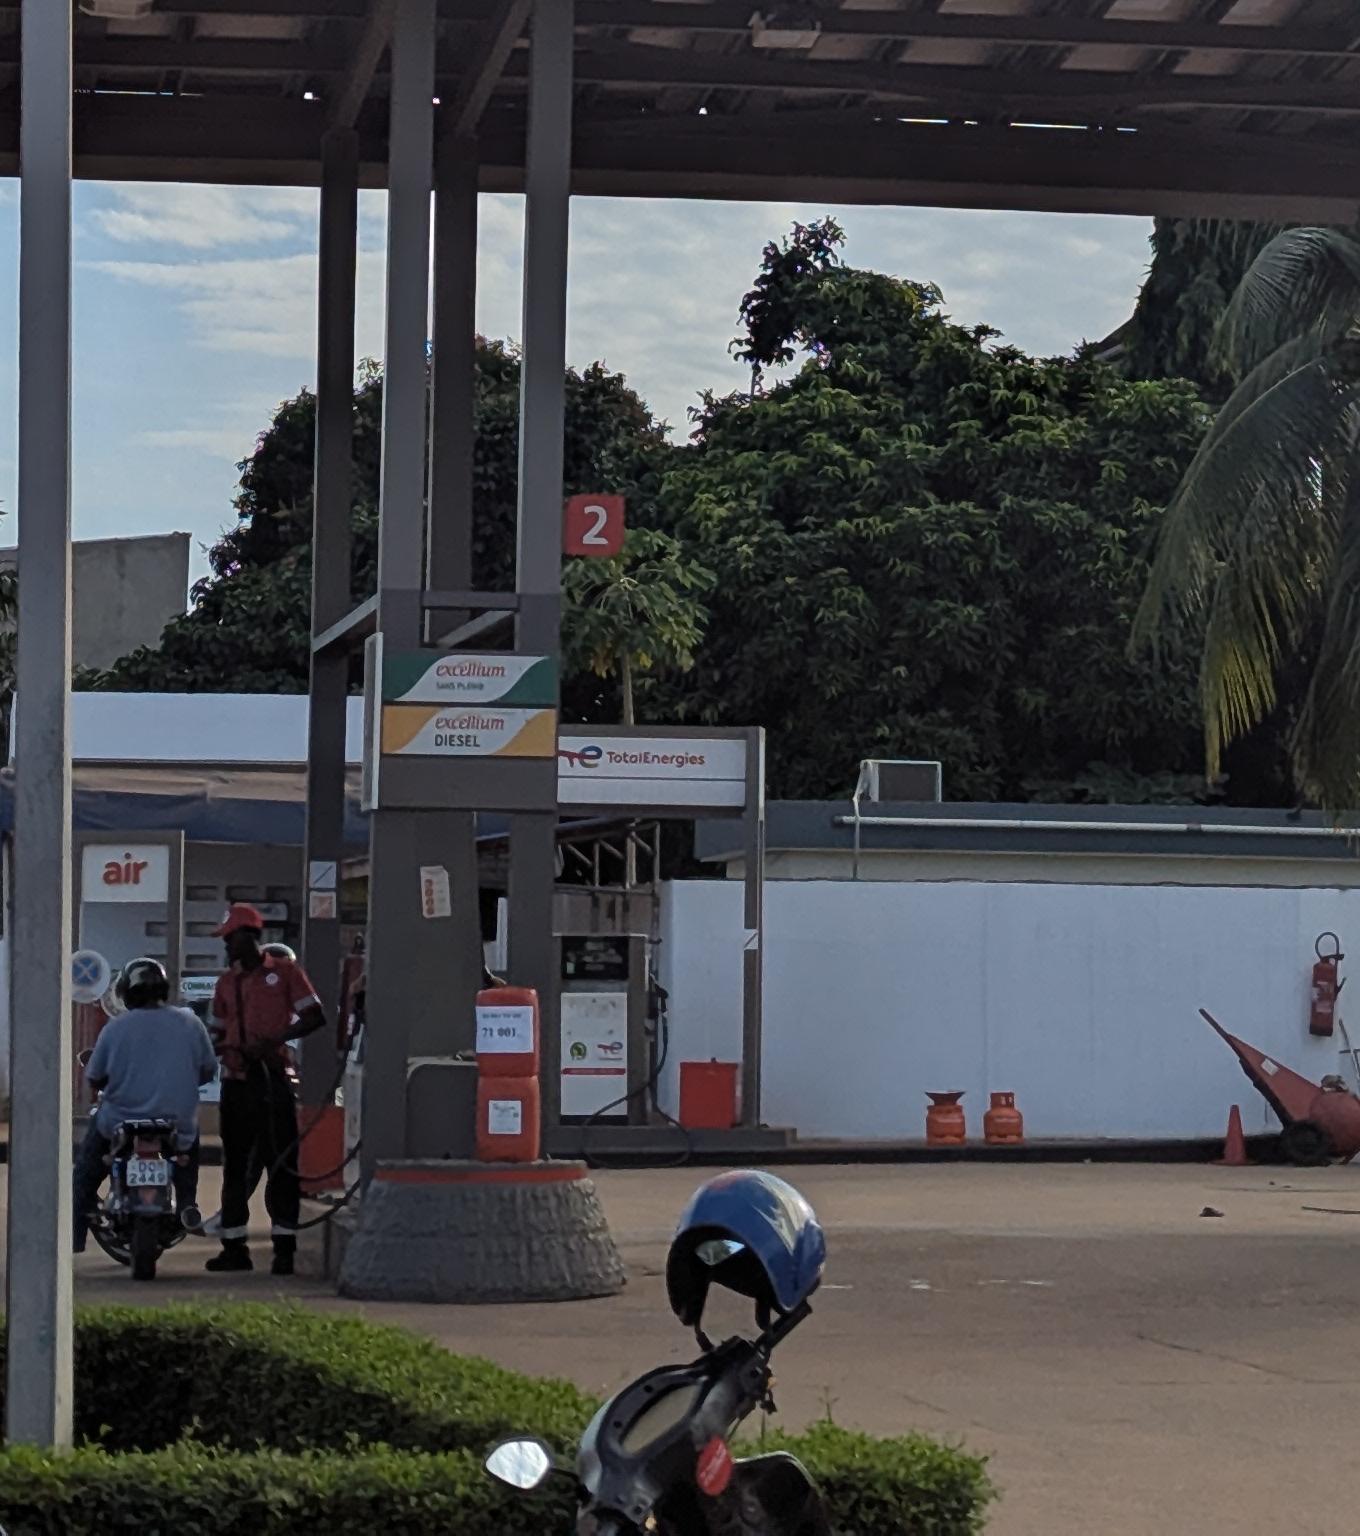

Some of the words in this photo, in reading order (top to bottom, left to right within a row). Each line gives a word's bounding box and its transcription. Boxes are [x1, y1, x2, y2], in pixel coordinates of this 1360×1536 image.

[583, 505, 609, 546] 2
[435, 661, 505, 677] excellium
[435, 715, 505, 730] excellium
[434, 734, 481, 747] DIESEL
[606, 751, 706, 768] TotalEnergies
[102, 852, 149, 885] air
